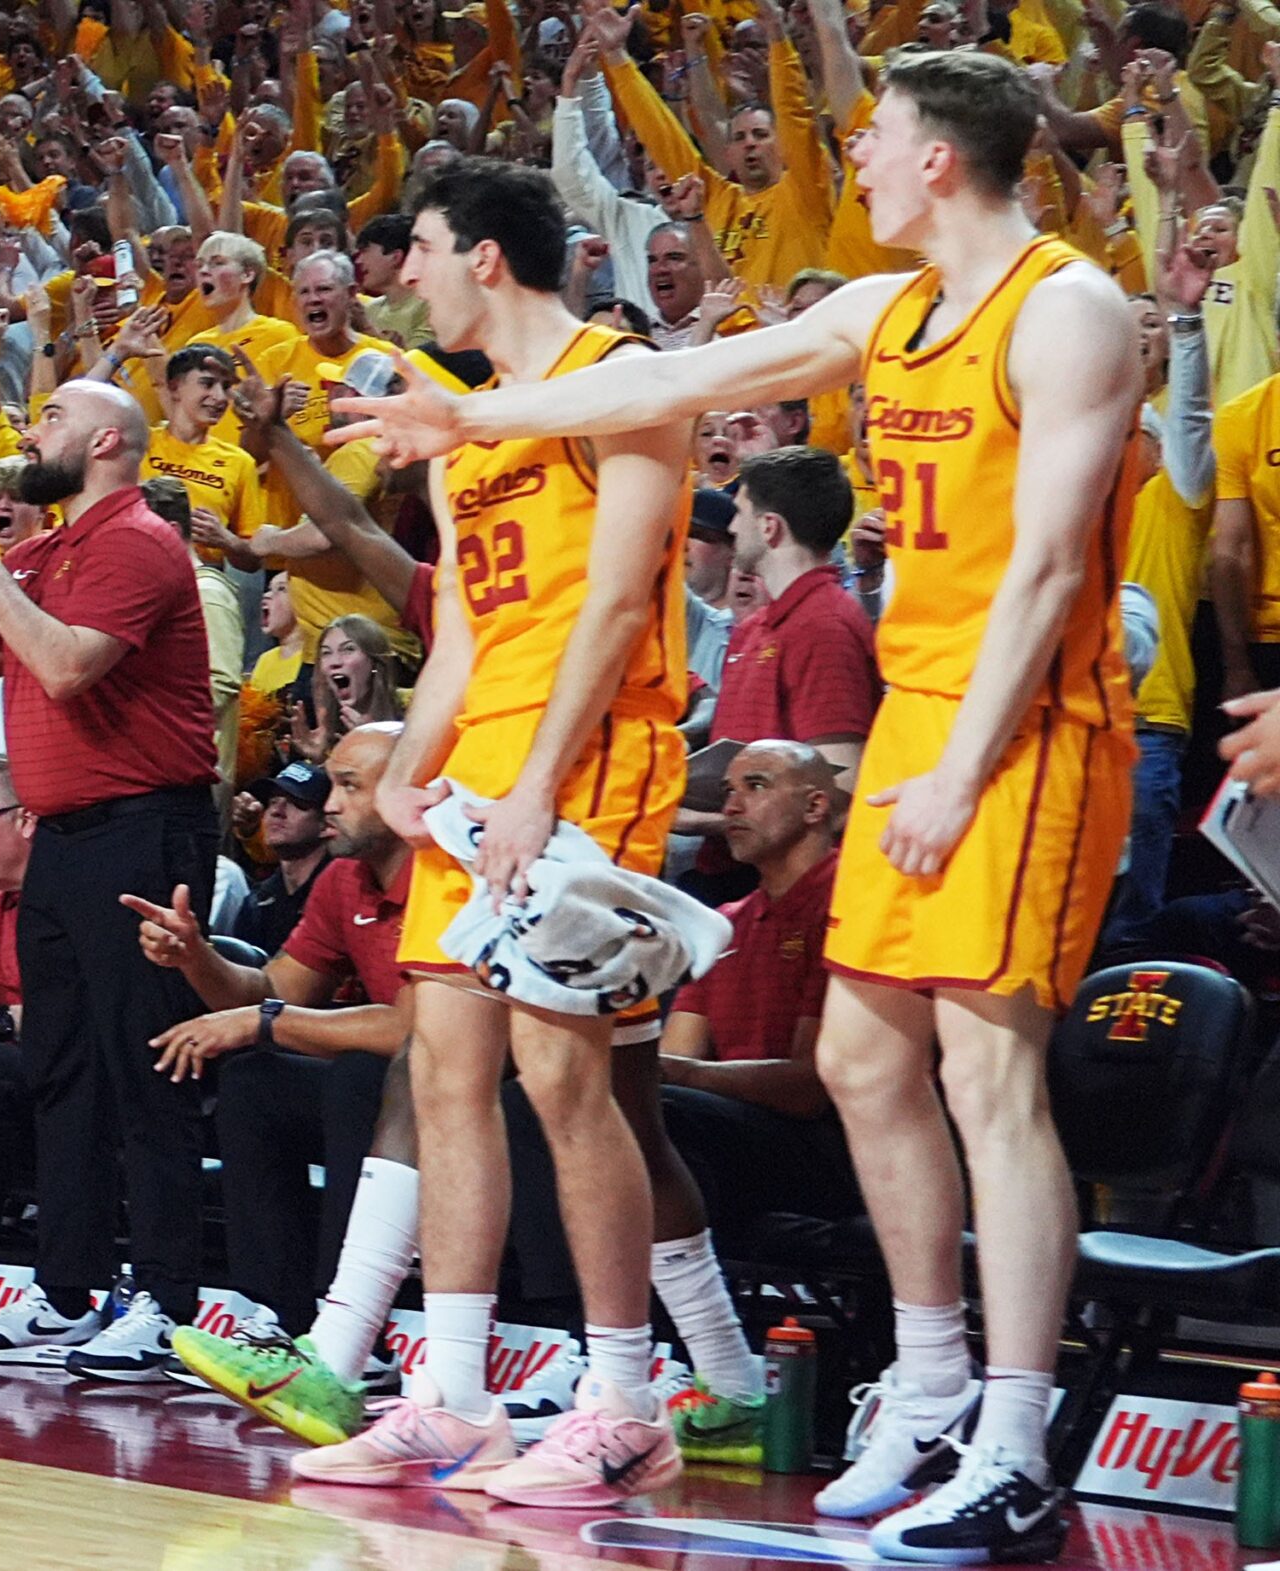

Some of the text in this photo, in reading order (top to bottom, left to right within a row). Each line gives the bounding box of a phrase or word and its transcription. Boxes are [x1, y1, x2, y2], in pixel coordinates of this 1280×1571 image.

[149, 457, 224, 489] Cyclones
[878, 459, 949, 550] 21
[458, 520, 529, 618] 22
[1086, 991, 1183, 1026] STATE
